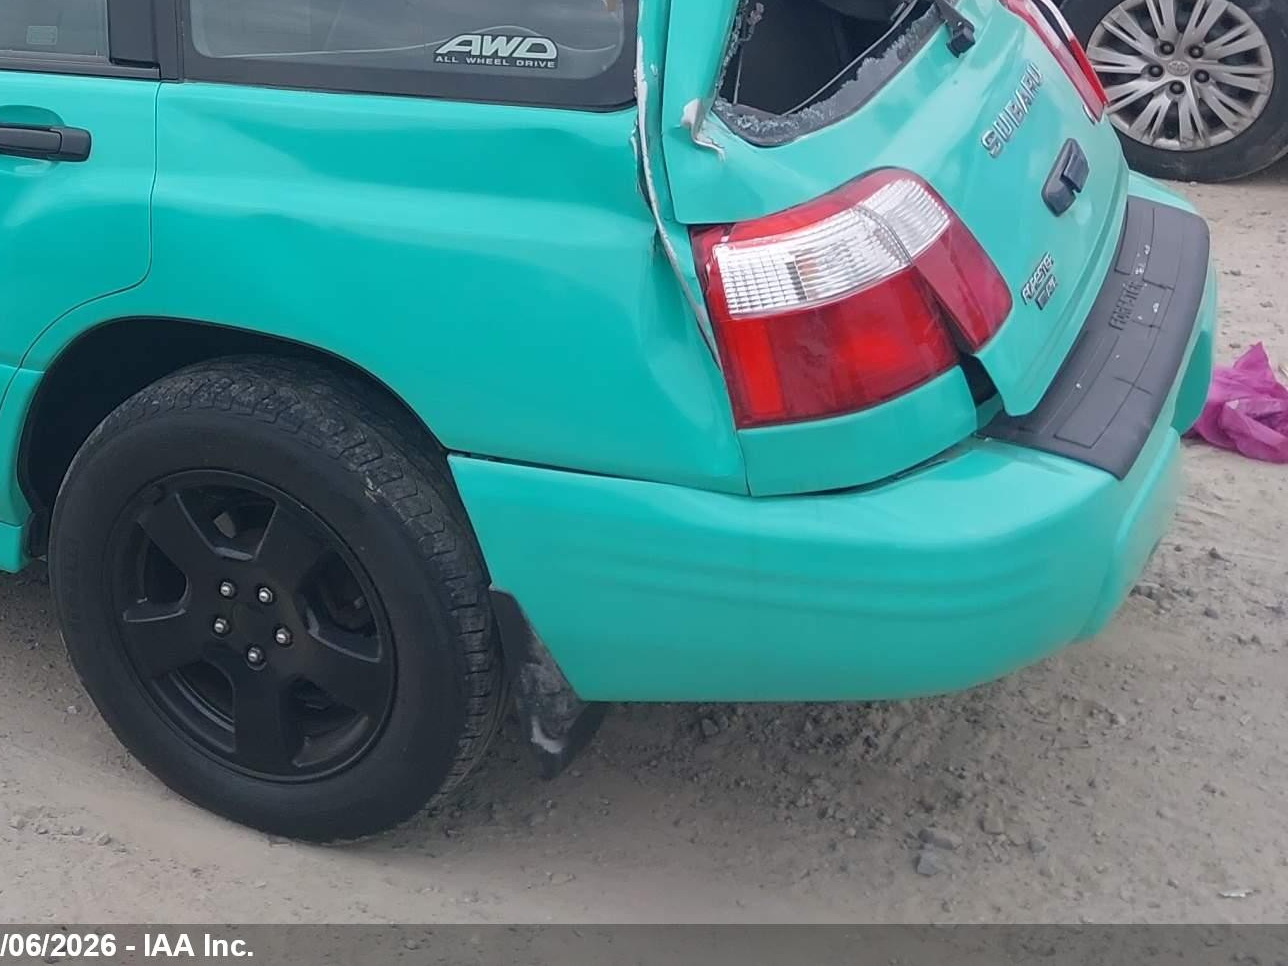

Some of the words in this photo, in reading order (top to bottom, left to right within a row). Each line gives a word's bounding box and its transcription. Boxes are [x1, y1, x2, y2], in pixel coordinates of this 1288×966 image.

[435, 34, 559, 60] AWD
[435, 55, 460, 64] ALL
[465, 57, 511, 67] WHEEL
[515, 59, 557, 69] DRIVE
[981, 62, 1043, 159] SUBARU
